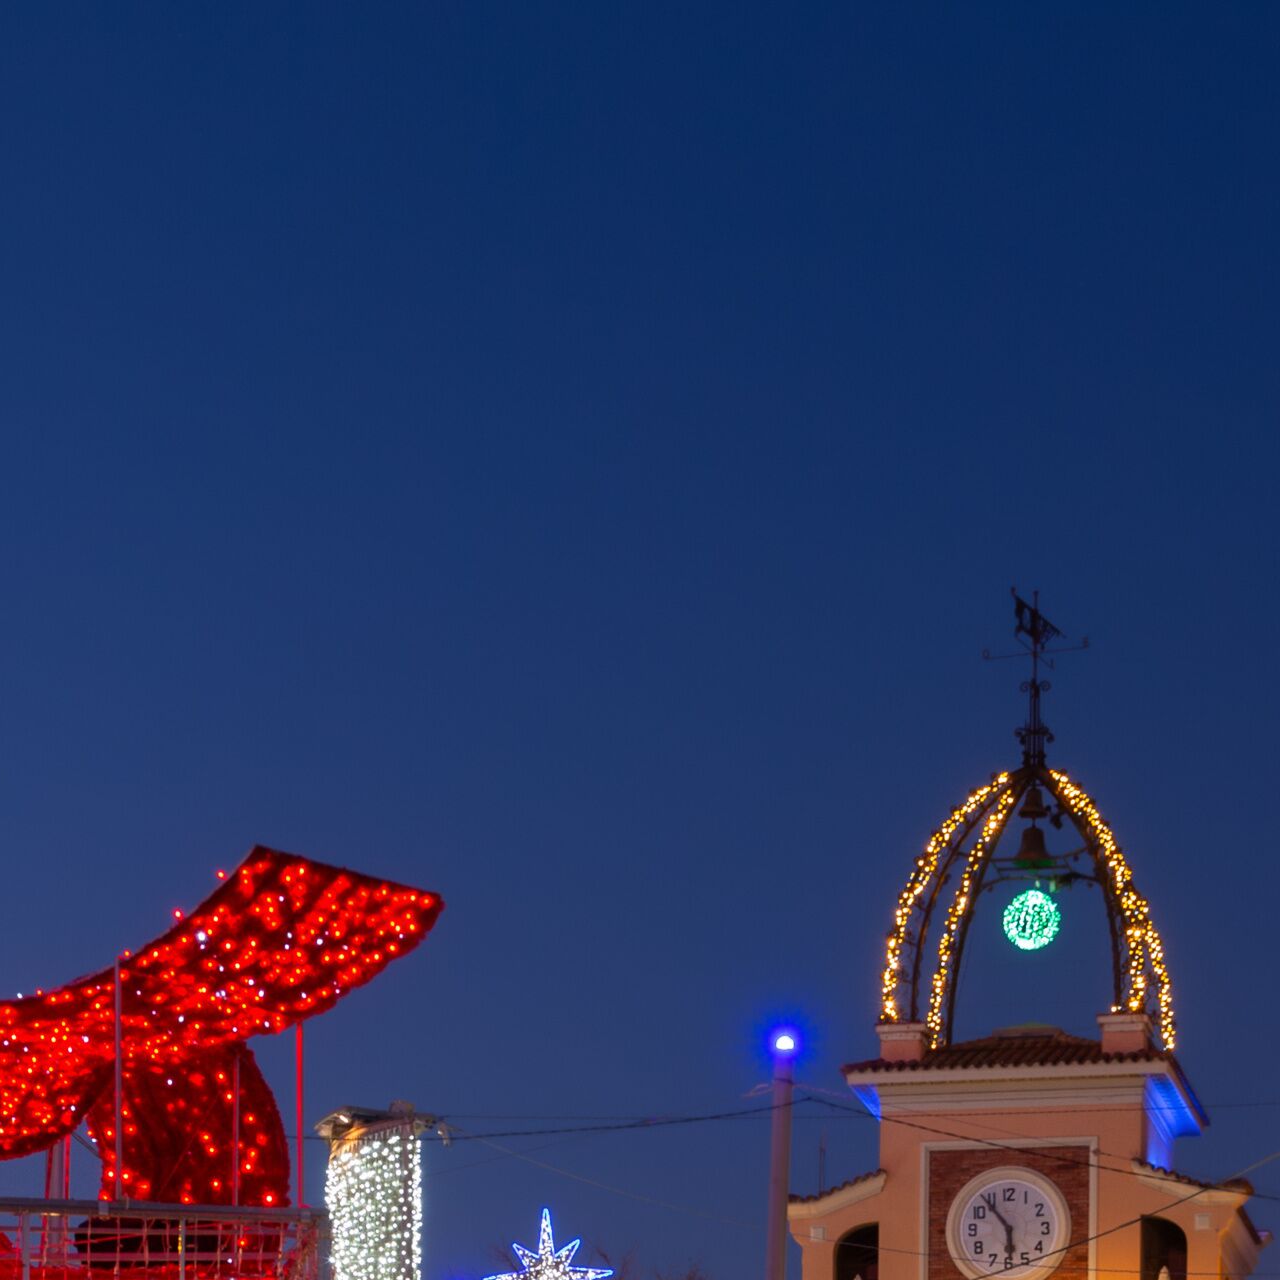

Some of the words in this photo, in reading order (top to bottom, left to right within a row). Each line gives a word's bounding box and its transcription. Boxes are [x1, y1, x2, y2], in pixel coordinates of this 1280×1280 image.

[1003, 1188, 1015, 1201] 12
[1024, 1191, 1027, 1204] 1
[973, 1206, 986, 1219] 10
[1035, 1203, 1044, 1217] 2
[968, 1223, 977, 1237] 9
[1041, 1221, 1050, 1235] 3
[974, 1241, 983, 1254] 8
[1034, 1240, 1043, 1253] 4
[988, 1254, 997, 1267] 7
[1004, 1257, 1013, 1270] 6
[1020, 1252, 1029, 1265] 5
